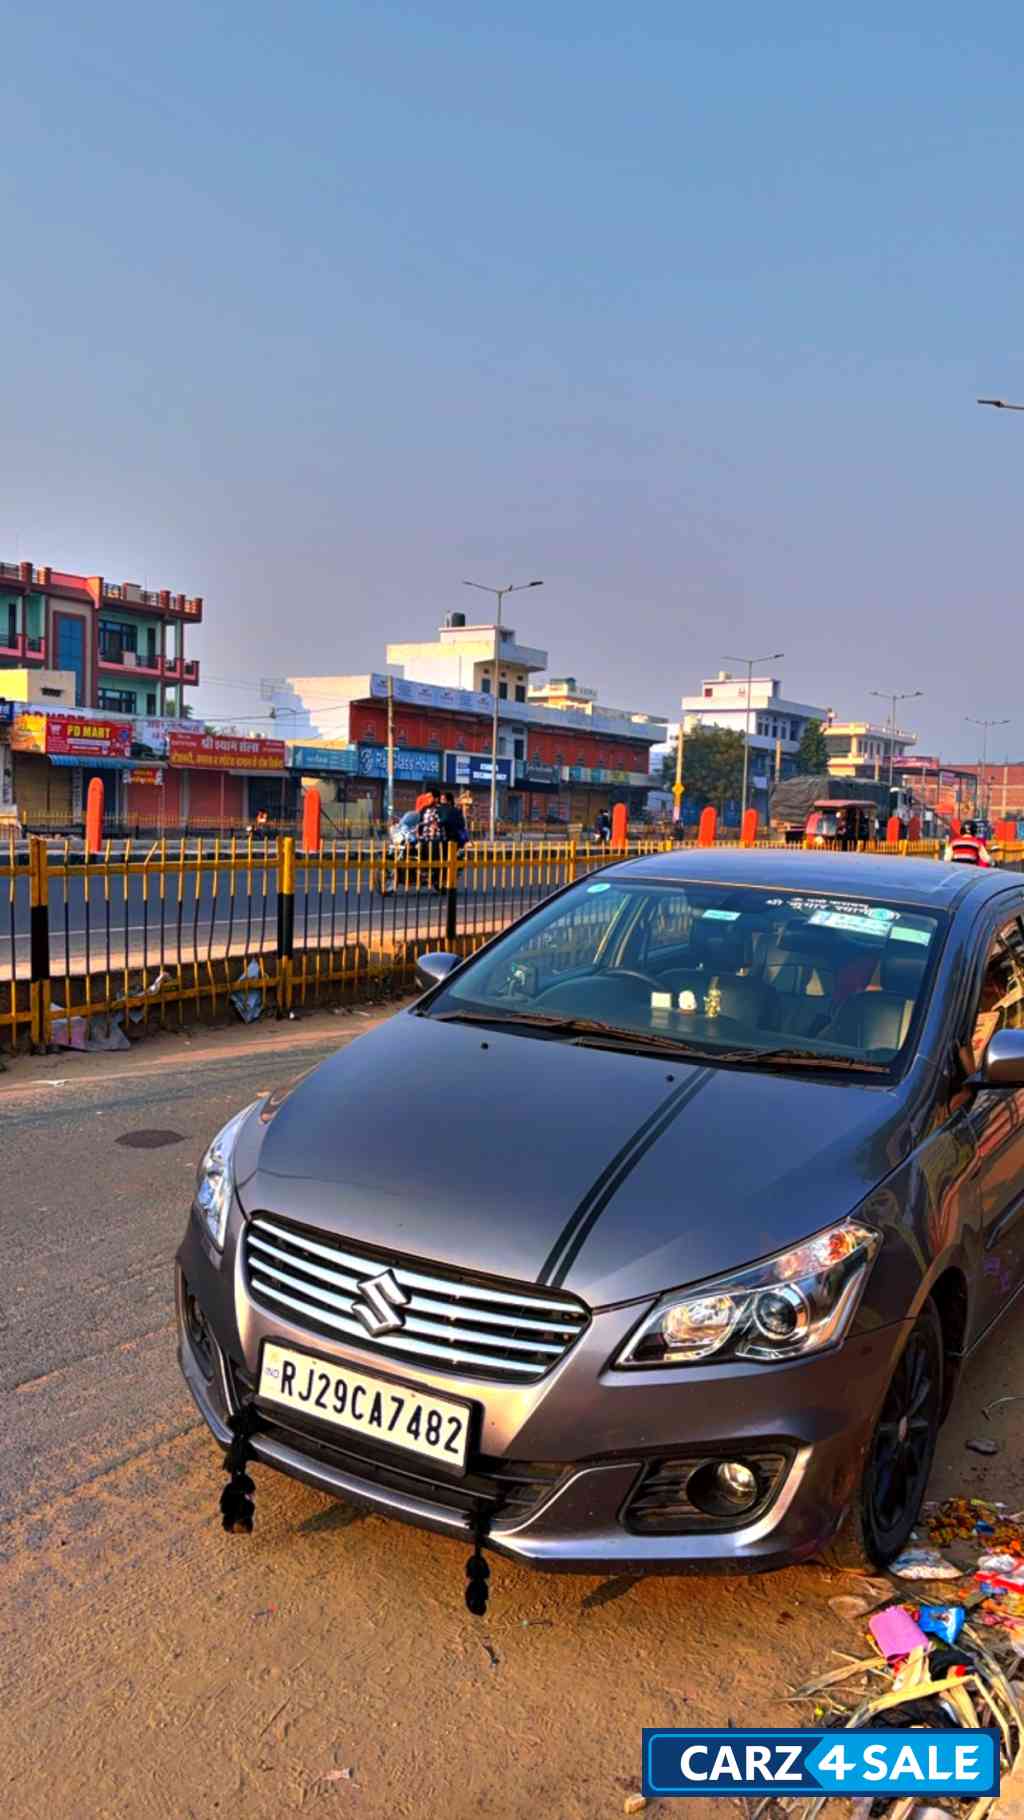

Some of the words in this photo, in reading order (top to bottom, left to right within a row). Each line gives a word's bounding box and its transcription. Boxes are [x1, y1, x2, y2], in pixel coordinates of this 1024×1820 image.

[67, 724, 81, 739] PD
[82, 725, 111, 739] MART
[280, 1359, 463, 1455] RJ29CA7482
